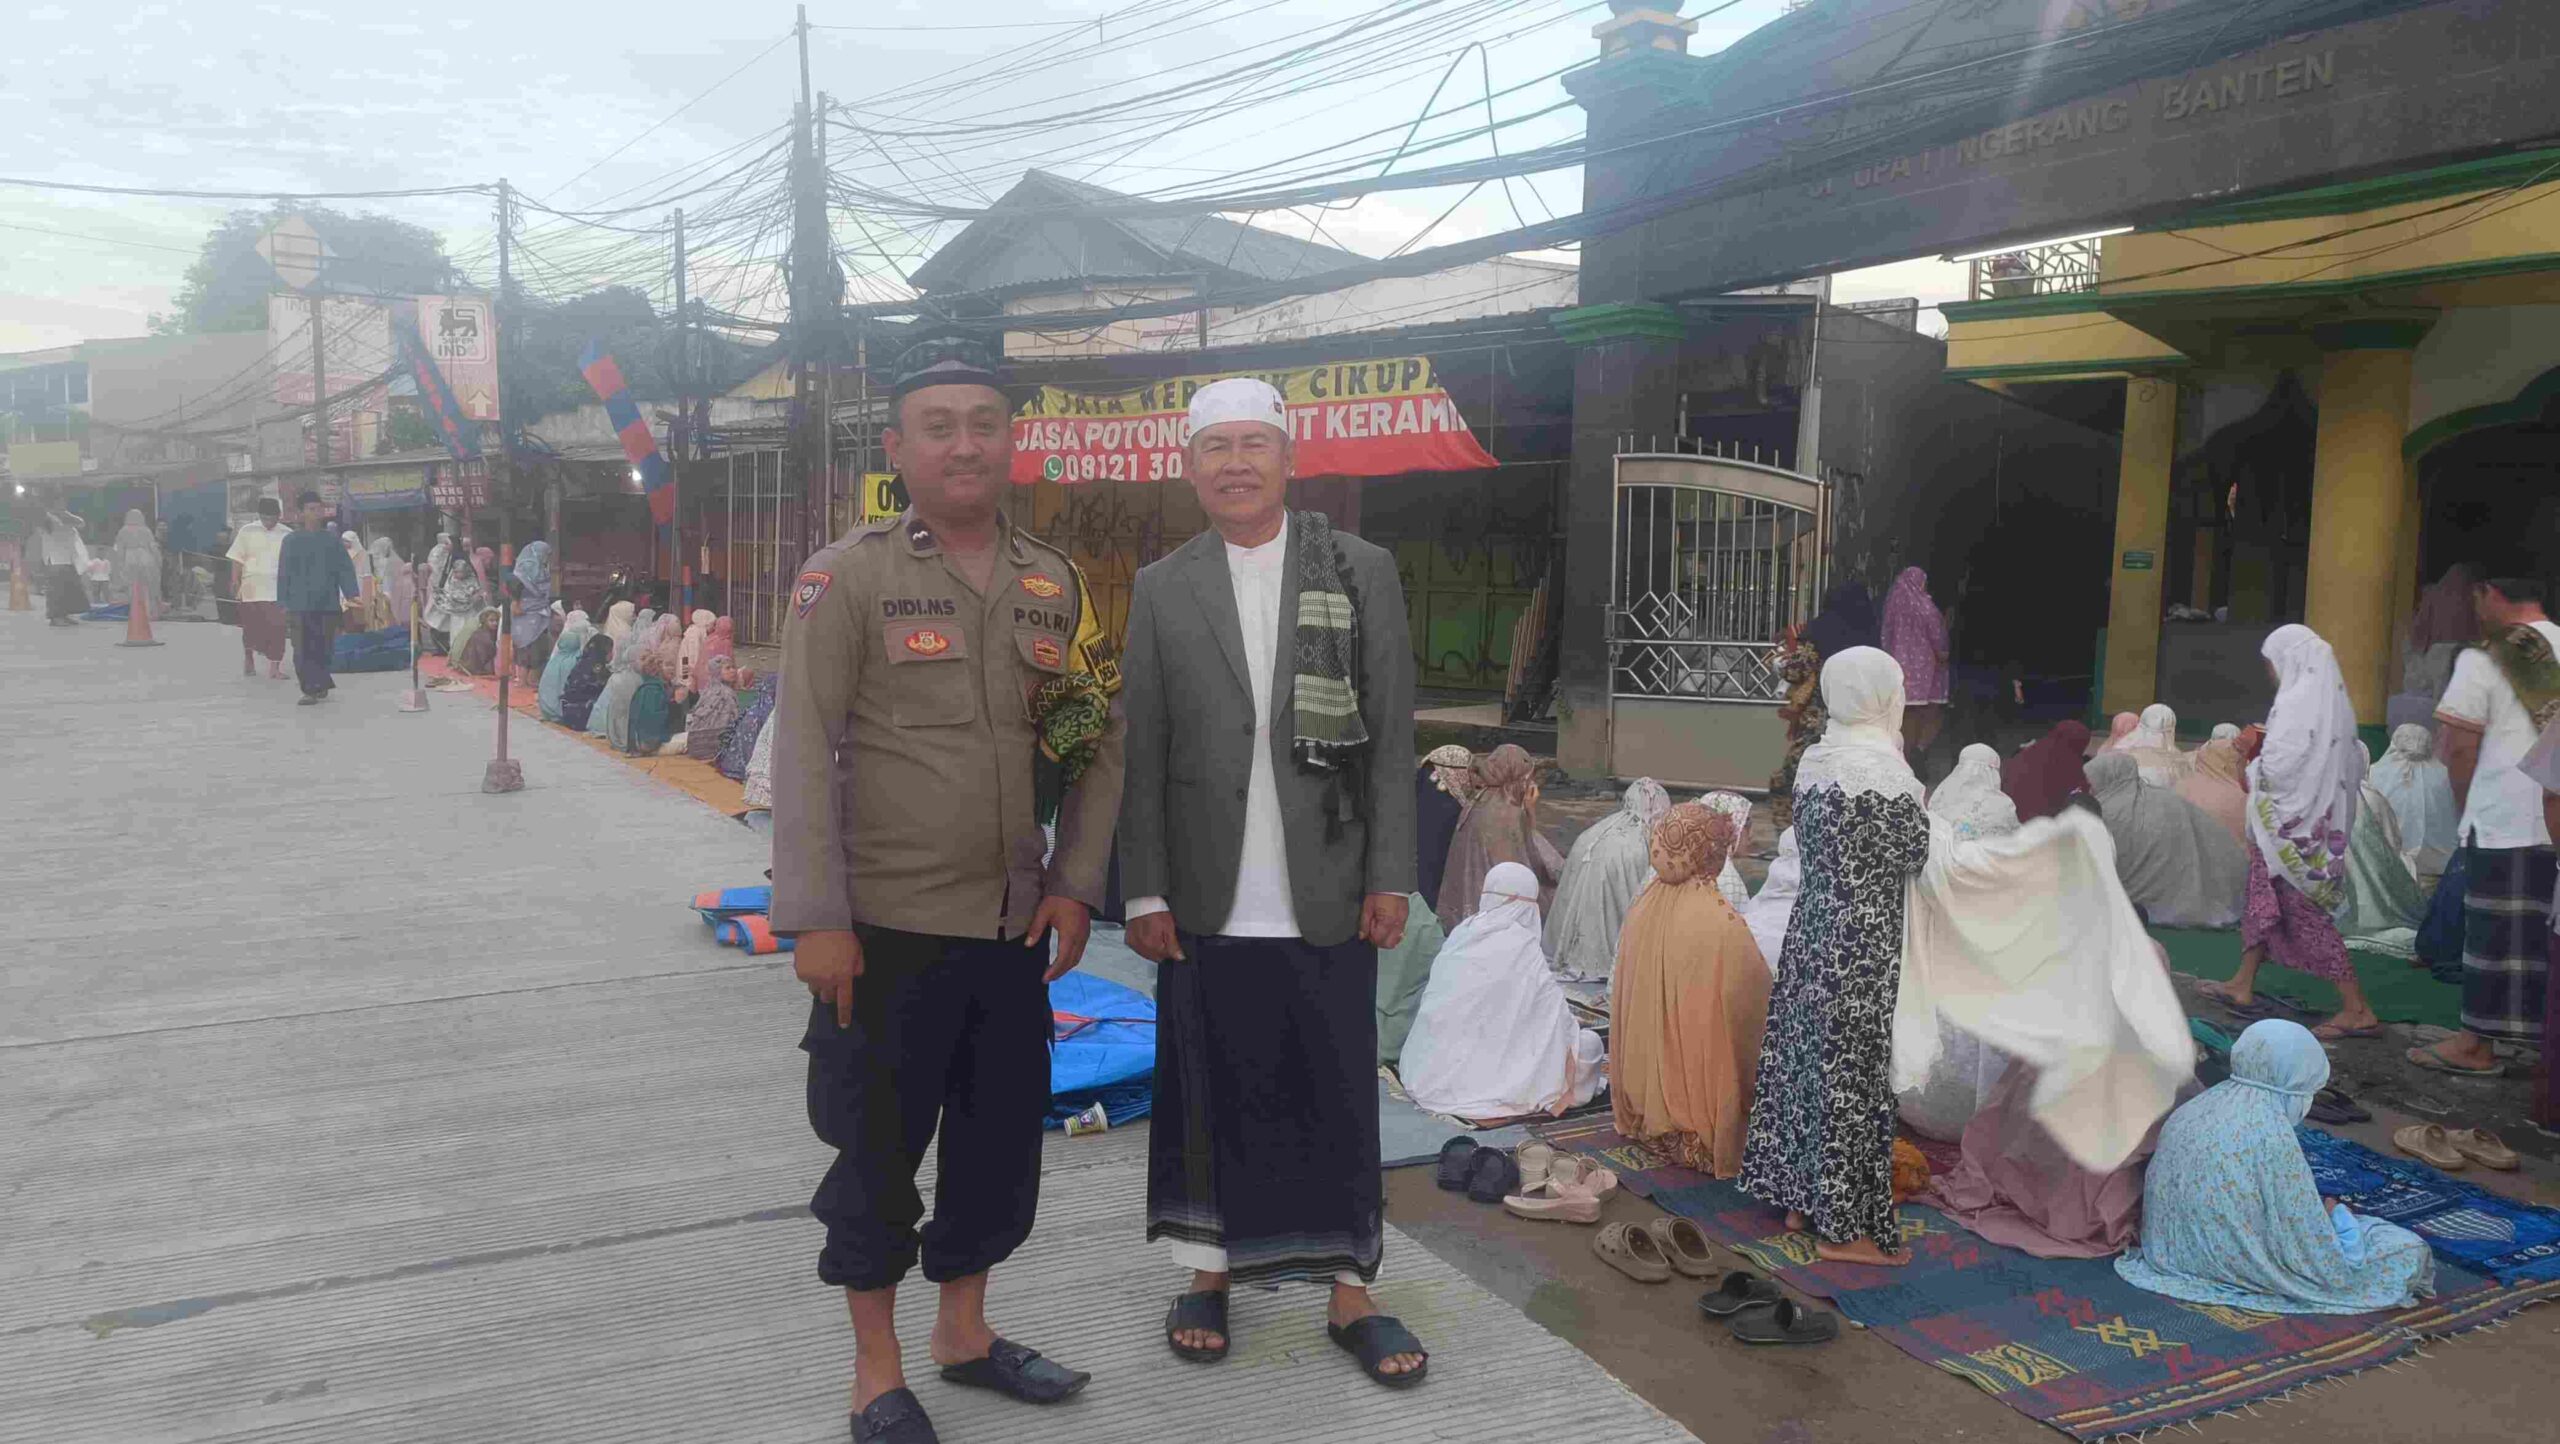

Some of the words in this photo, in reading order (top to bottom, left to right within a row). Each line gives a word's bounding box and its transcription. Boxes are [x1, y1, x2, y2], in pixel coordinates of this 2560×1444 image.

[2163, 51, 2335, 120] BANTEN
[1015, 421, 1080, 451] JASA
[1084, 416, 1190, 450] POTONG
[1066, 453, 1138, 481] 08121
[433, 486, 483, 496] BENGEL
[882, 598, 957, 618] DIDI.MS
[1013, 607, 1070, 633] POLRI
